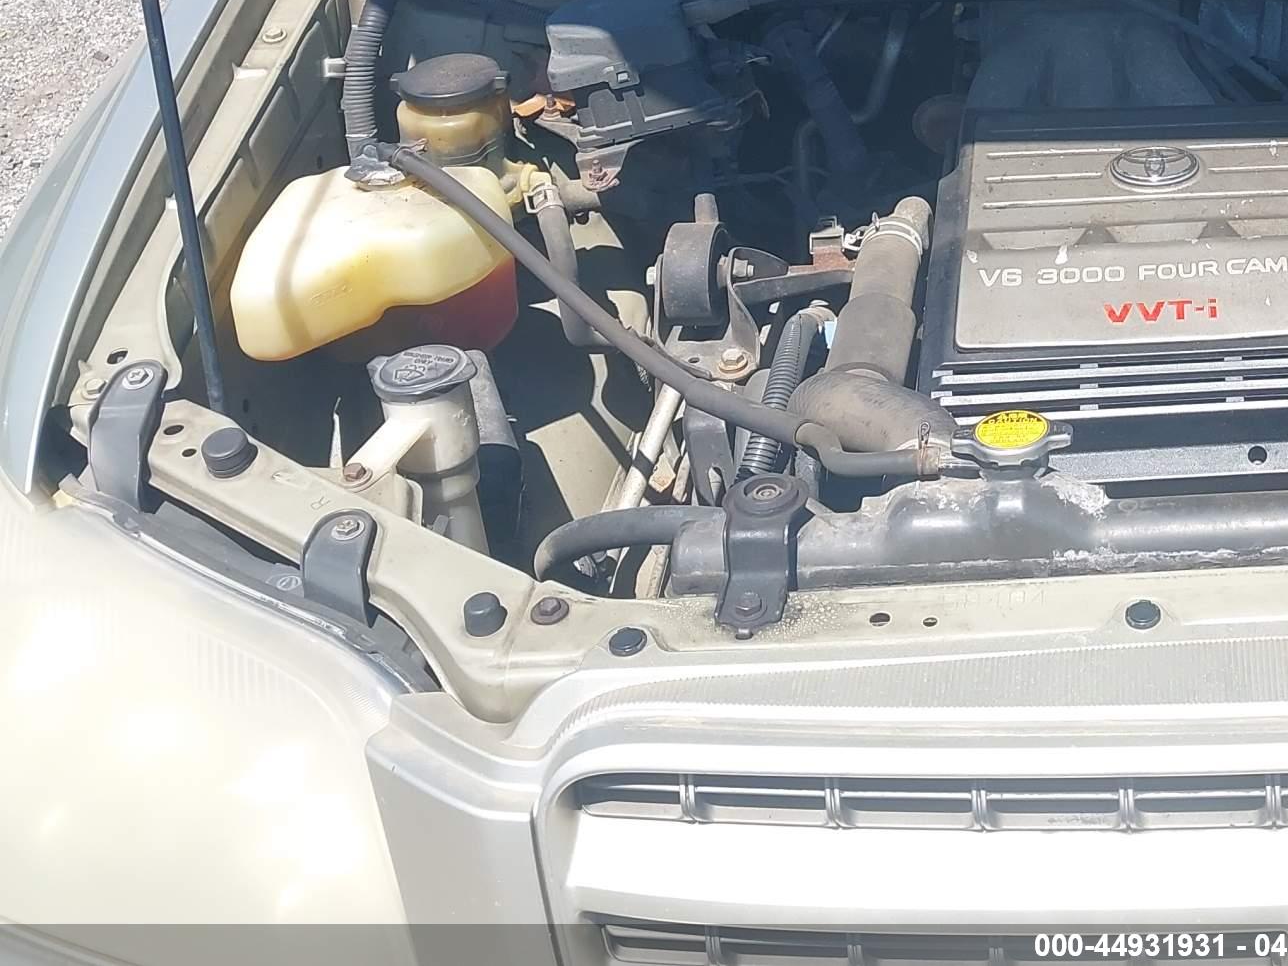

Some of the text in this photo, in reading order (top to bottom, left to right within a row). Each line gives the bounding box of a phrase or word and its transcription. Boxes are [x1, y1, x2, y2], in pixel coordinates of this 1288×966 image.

[979, 268, 1023, 287] V6
[1036, 265, 1126, 285] 3000
[1138, 259, 1221, 282] FOUR
[1225, 255, 1288, 276] CAM
[1103, 298, 1220, 324] VVT-i
